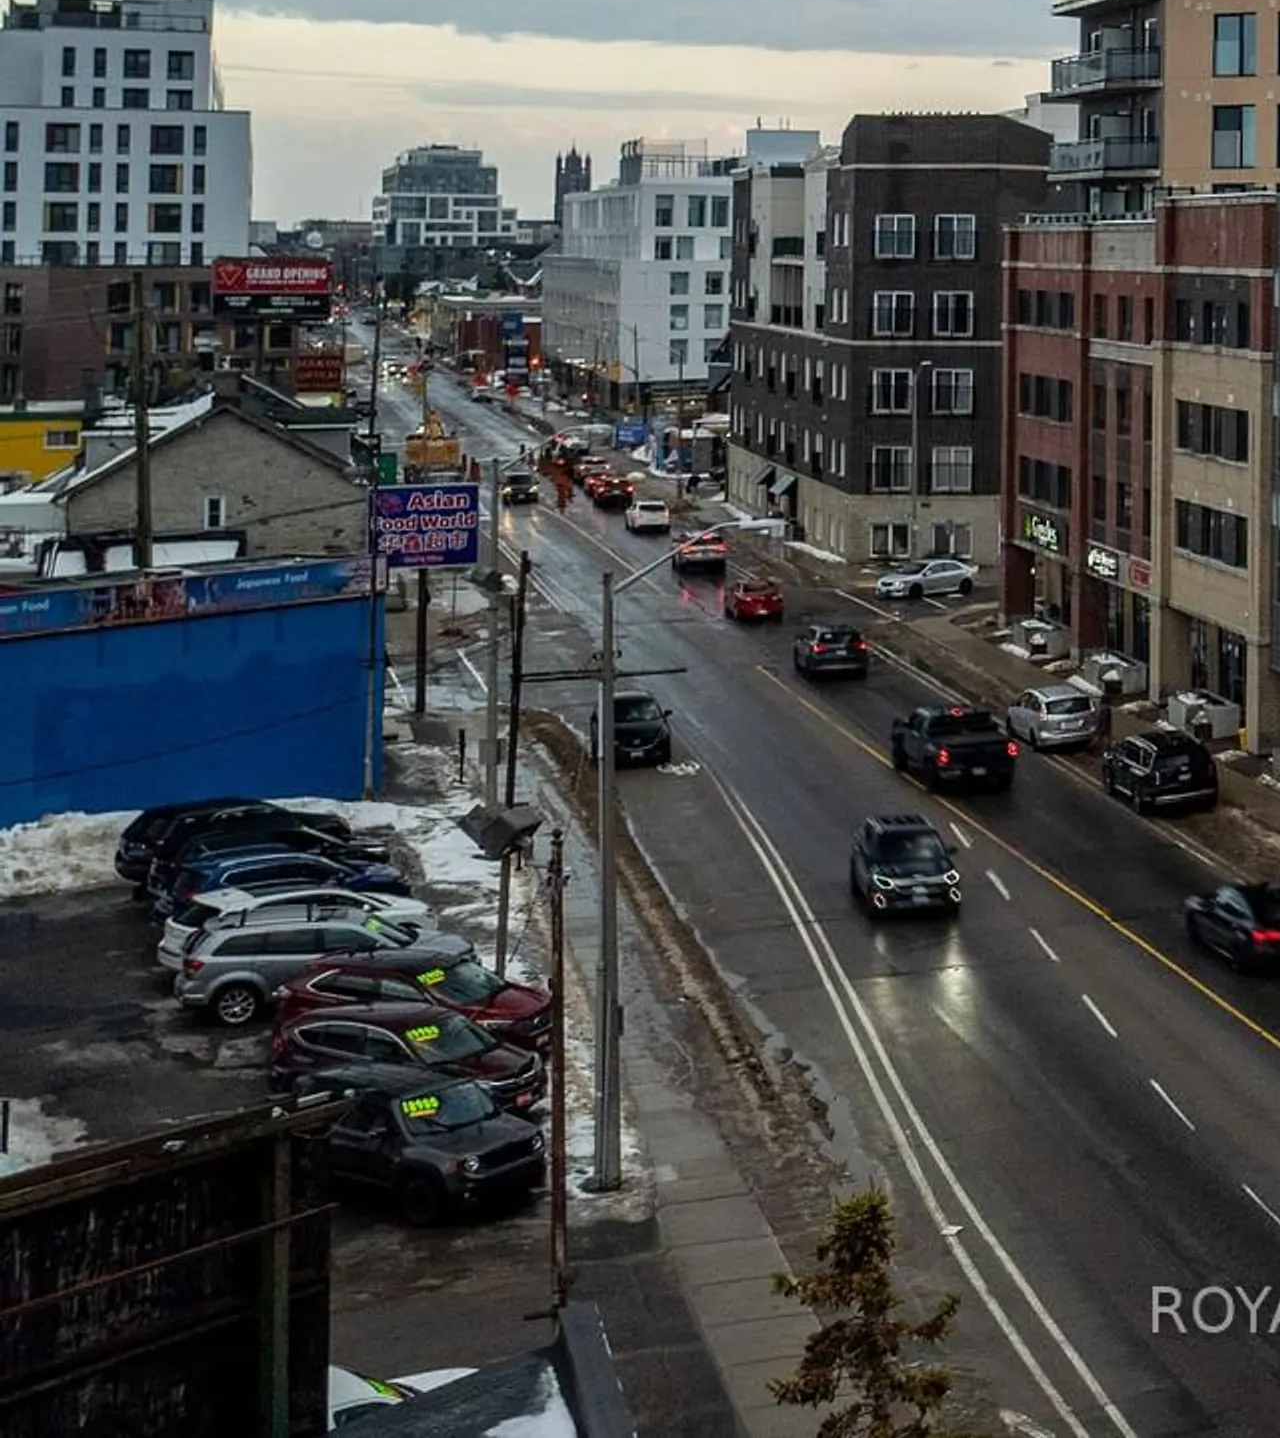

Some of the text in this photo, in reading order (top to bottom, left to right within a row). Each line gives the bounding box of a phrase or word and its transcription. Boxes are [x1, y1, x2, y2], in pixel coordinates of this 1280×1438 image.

[246, 267, 281, 280] GRAND
[406, 491, 470, 511] Asian
[420, 511, 477, 530] World
